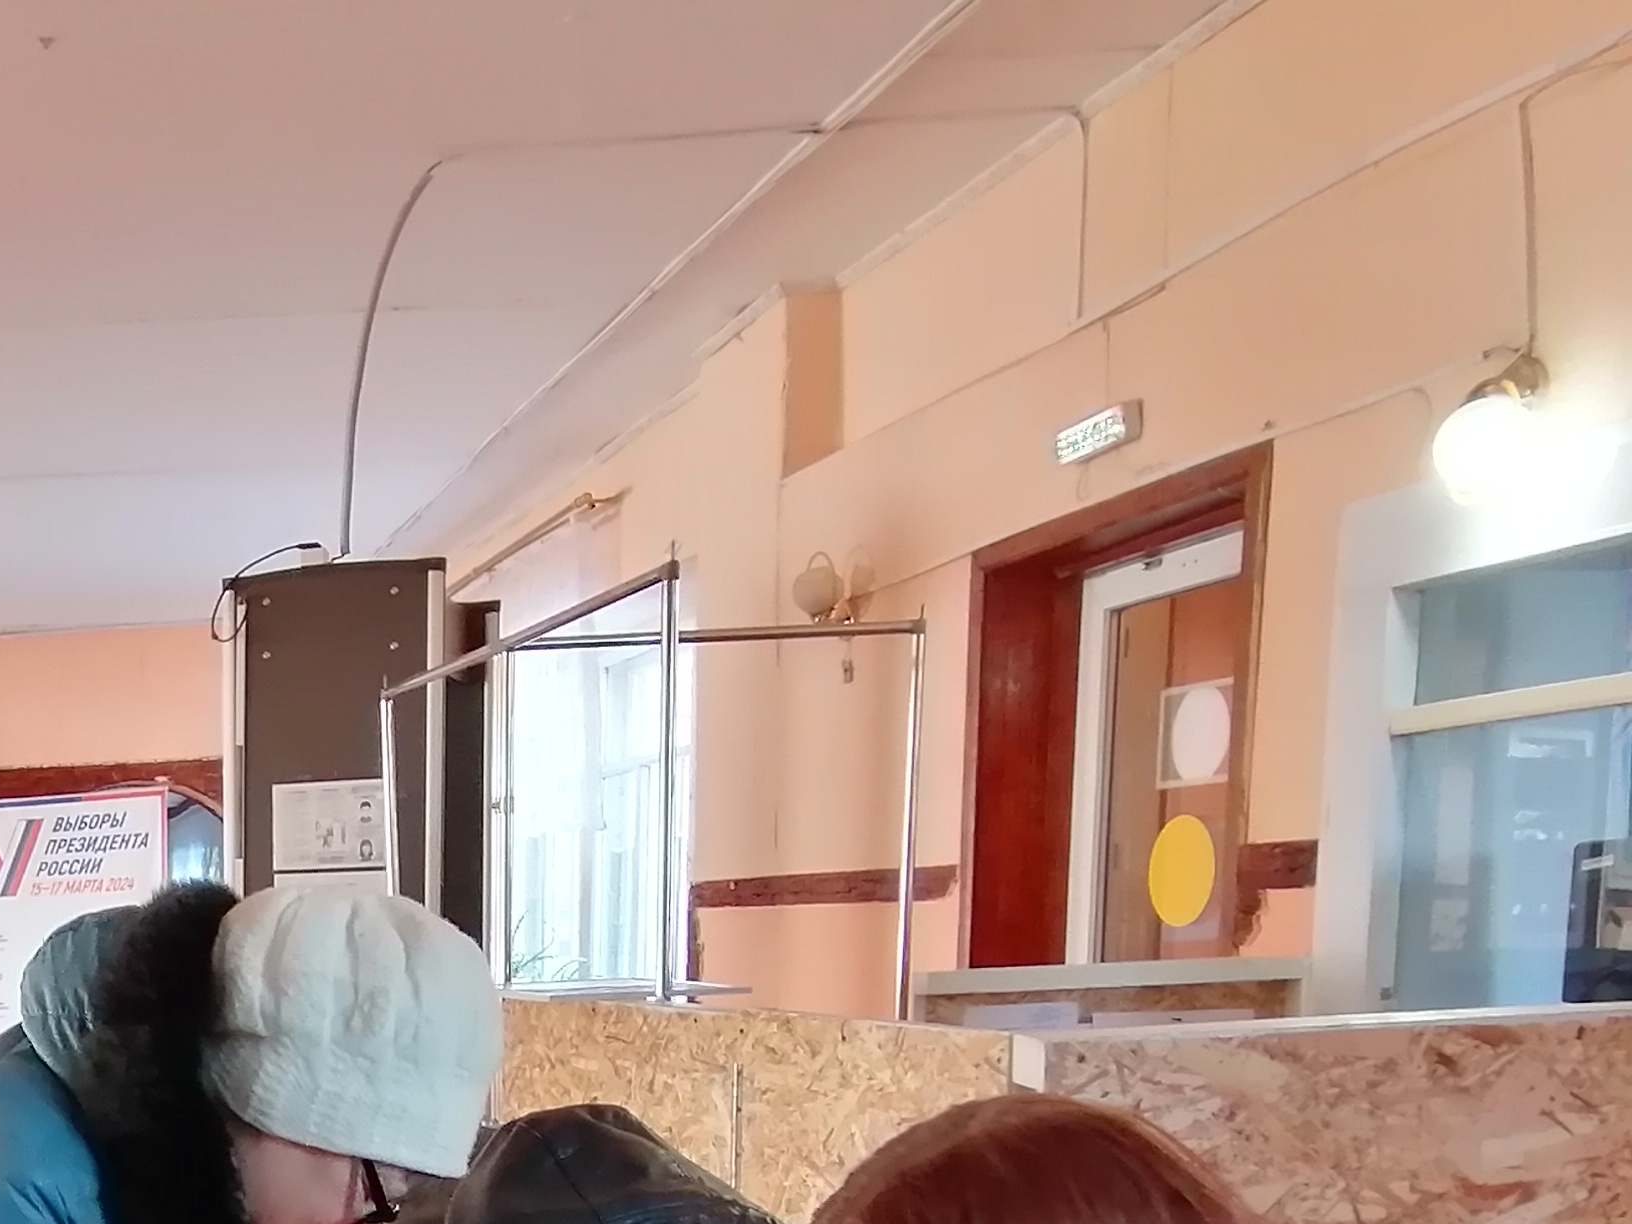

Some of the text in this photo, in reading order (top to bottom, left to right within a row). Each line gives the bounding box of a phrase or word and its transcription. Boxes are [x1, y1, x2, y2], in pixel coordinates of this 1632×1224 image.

[52, 811, 127, 833] ВЫБОРЫ
[44, 832, 149, 856] ПРЕЗИДЕНТА
[36, 858, 103, 877] РОССИИ
[63, 878, 104, 895] МАРТА
[105, 876, 135, 893] 2024
